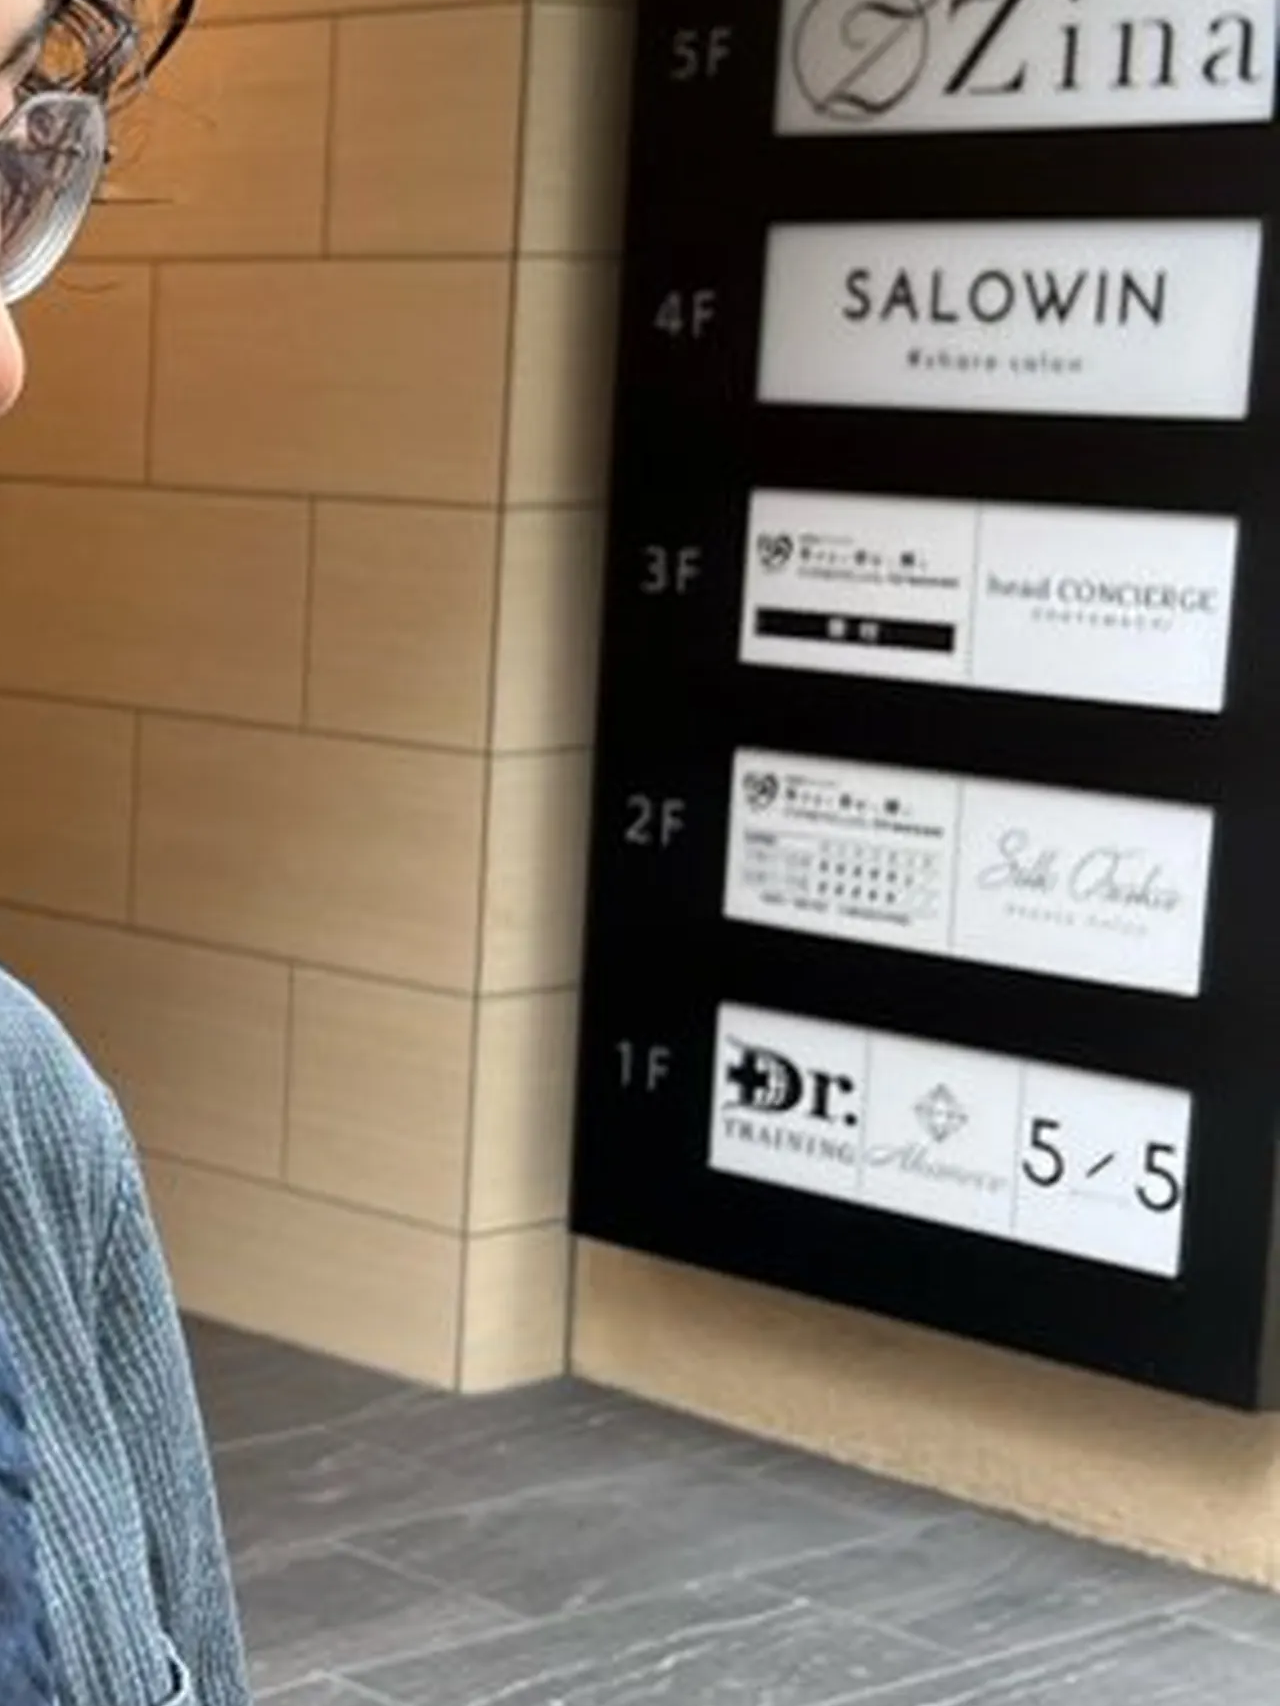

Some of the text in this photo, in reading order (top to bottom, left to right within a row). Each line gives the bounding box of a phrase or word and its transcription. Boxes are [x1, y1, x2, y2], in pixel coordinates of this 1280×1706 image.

[668, 25, 734, 82] 5F
[653, 290, 717, 338] 4F
[841, 268, 1168, 326] SALOWIN
[642, 546, 703, 593] 3F
[1056, 577, 1219, 614] CONCIERGE
[624, 795, 686, 848] 2F
[615, 1039, 672, 1092] 1F
[722, 1117, 856, 1167] TRAINING
